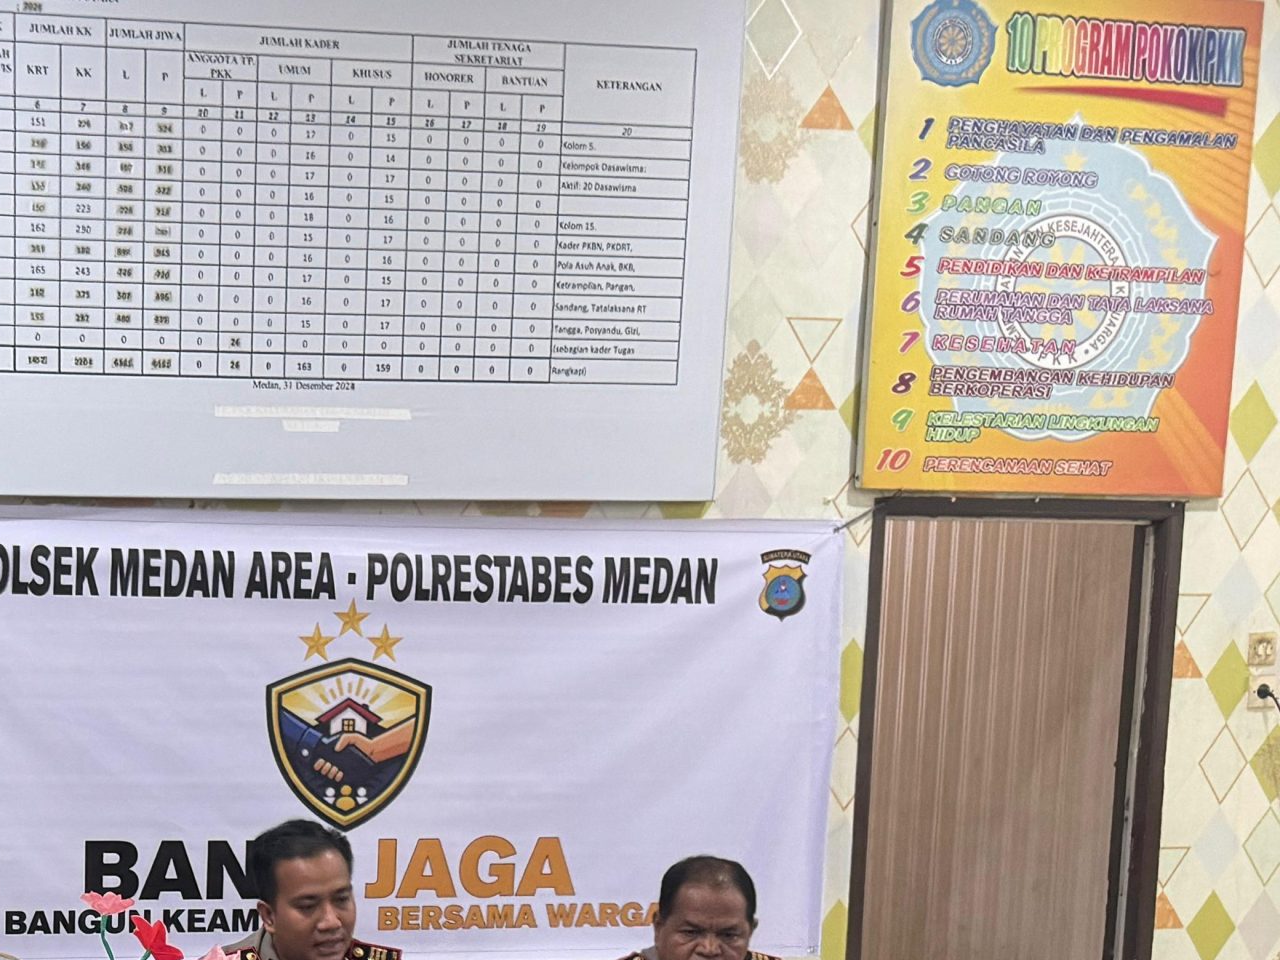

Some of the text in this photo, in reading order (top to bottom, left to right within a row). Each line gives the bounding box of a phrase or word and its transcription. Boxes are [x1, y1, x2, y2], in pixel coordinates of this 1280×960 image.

[29, 23, 92, 37] JUMLAH KK
[109, 28, 182, 41] JUMLAH JIWA
[259, 36, 339, 50] JUMLAH KADER
[447, 39, 531, 53] JUMLAH TENAGA
[1008, 13, 1246, 86] 10 PROGRAM POKOK PKK
[187, 53, 238, 65] ANGGOTA
[455, 54, 523, 66] SEKRETARIAT
[26, 64, 48, 75] KRT
[75, 66, 92, 78] KK
[210, 68, 232, 79] PKK
[278, 64, 311, 76] UMUM
[353, 68, 392, 79] KHUSUS
[424, 72, 474, 83] HONORER
[502, 75, 548, 87] BANTUAN
[596, 79, 662, 91] KETERANGAN
[919, 117, 1237, 148] 1 PENGHAYATAN DAN PENGAMALAN
[563, 142, 587, 151] Kolom
[946, 134, 1046, 154] PANCASILA
[562, 162, 599, 172] Kelompok
[909, 158, 1099, 188] 2 GOTONG ROYONG
[583, 183, 593, 191] 20
[594, 183, 637, 192] Dasawisma
[907, 191, 1042, 216] 3 PANGAN
[560, 222, 583, 231] Kolom
[905, 223, 1056, 248] 4 SANDANG
[558, 241, 579, 250] Kader
[900, 256, 1206, 284] 5 PENDIDIKAN DAN KETRAMPILAN
[901, 288, 1214, 315] 6 PERUMAHAN DAN TATA LAKSANA
[637, 305, 647, 313] RT
[934, 305, 1073, 325] RUMAH TANGGA
[590, 345, 611, 354] kader
[614, 345, 635, 355] Tugas
[900, 332, 1077, 354] 7 KESEHATAN
[296, 381, 333, 391] Desember
[892, 365, 1176, 394] 8 PENGEMBANGAN KEHIDUPAN
[929, 381, 1053, 399] BERKOPERASI
[891, 409, 1160, 433] 9 KELESTARIAN LINGKUNGAN
[925, 427, 981, 443] HIDUP
[876, 449, 1113, 476] 10 PERENCANAAN SEHAT
[110, 547, 235, 599] MEDAN
[244, 551, 336, 600] AREA
[366, 552, 593, 604] POLRESTABES
[602, 557, 718, 605] MEDAN
[84, 835, 576, 900] BAN JAGA
[162, 909, 259, 934] KEAM
[377, 904, 537, 931] BERSAMA
